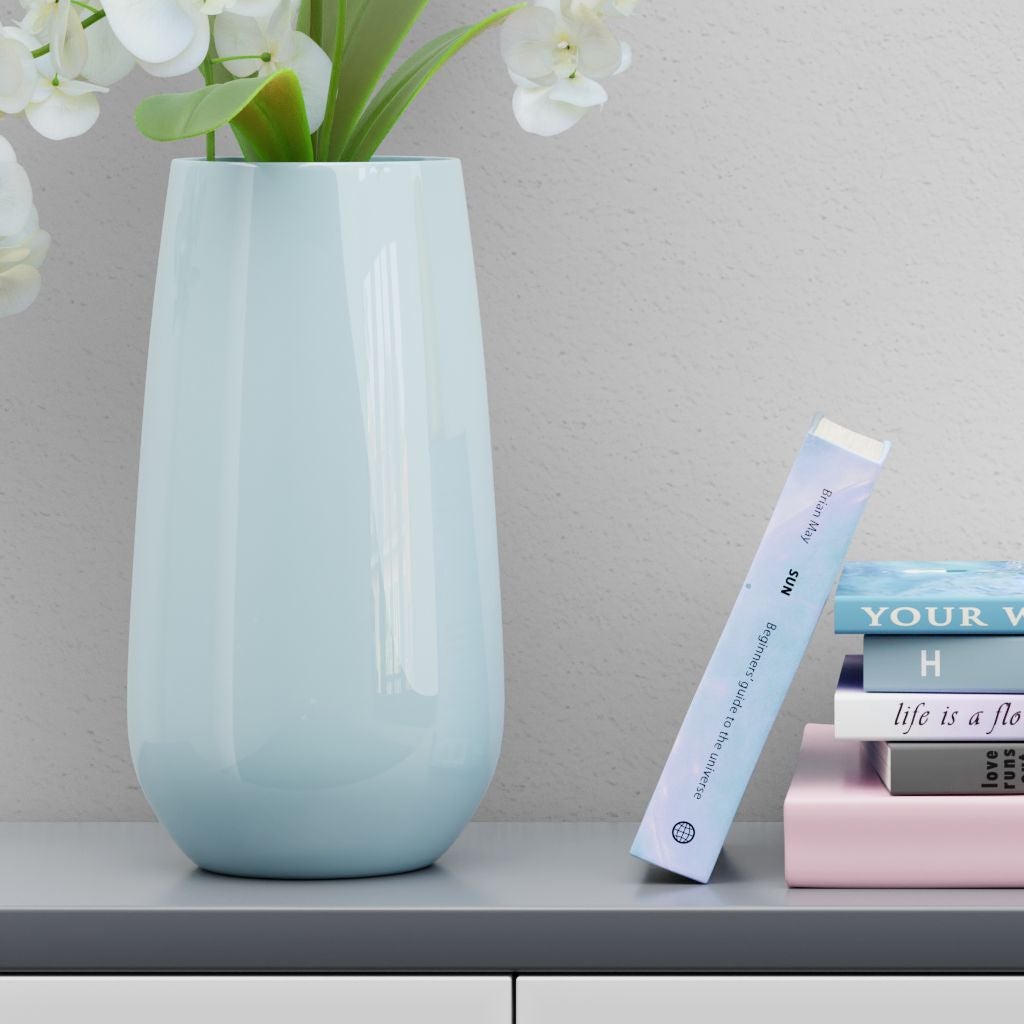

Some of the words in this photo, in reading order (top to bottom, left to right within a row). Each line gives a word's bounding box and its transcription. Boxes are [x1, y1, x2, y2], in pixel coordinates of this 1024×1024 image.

[813, 488, 833, 517] Brian
[801, 520, 820, 544] May
[781, 569, 799, 596] SUN
[861, 607, 989, 627] YOUR
[745, 622, 777, 682] Beginners'
[729, 681, 748, 714] guide
[723, 716, 735, 728] to
[894, 702, 930, 734] life
[941, 706, 958, 726] is
[968, 710, 984, 726] a
[714, 731, 728, 750] the
[693, 752, 719, 800] universe
[981, 750, 998, 788] love
[1003, 749, 1016, 789] runs
